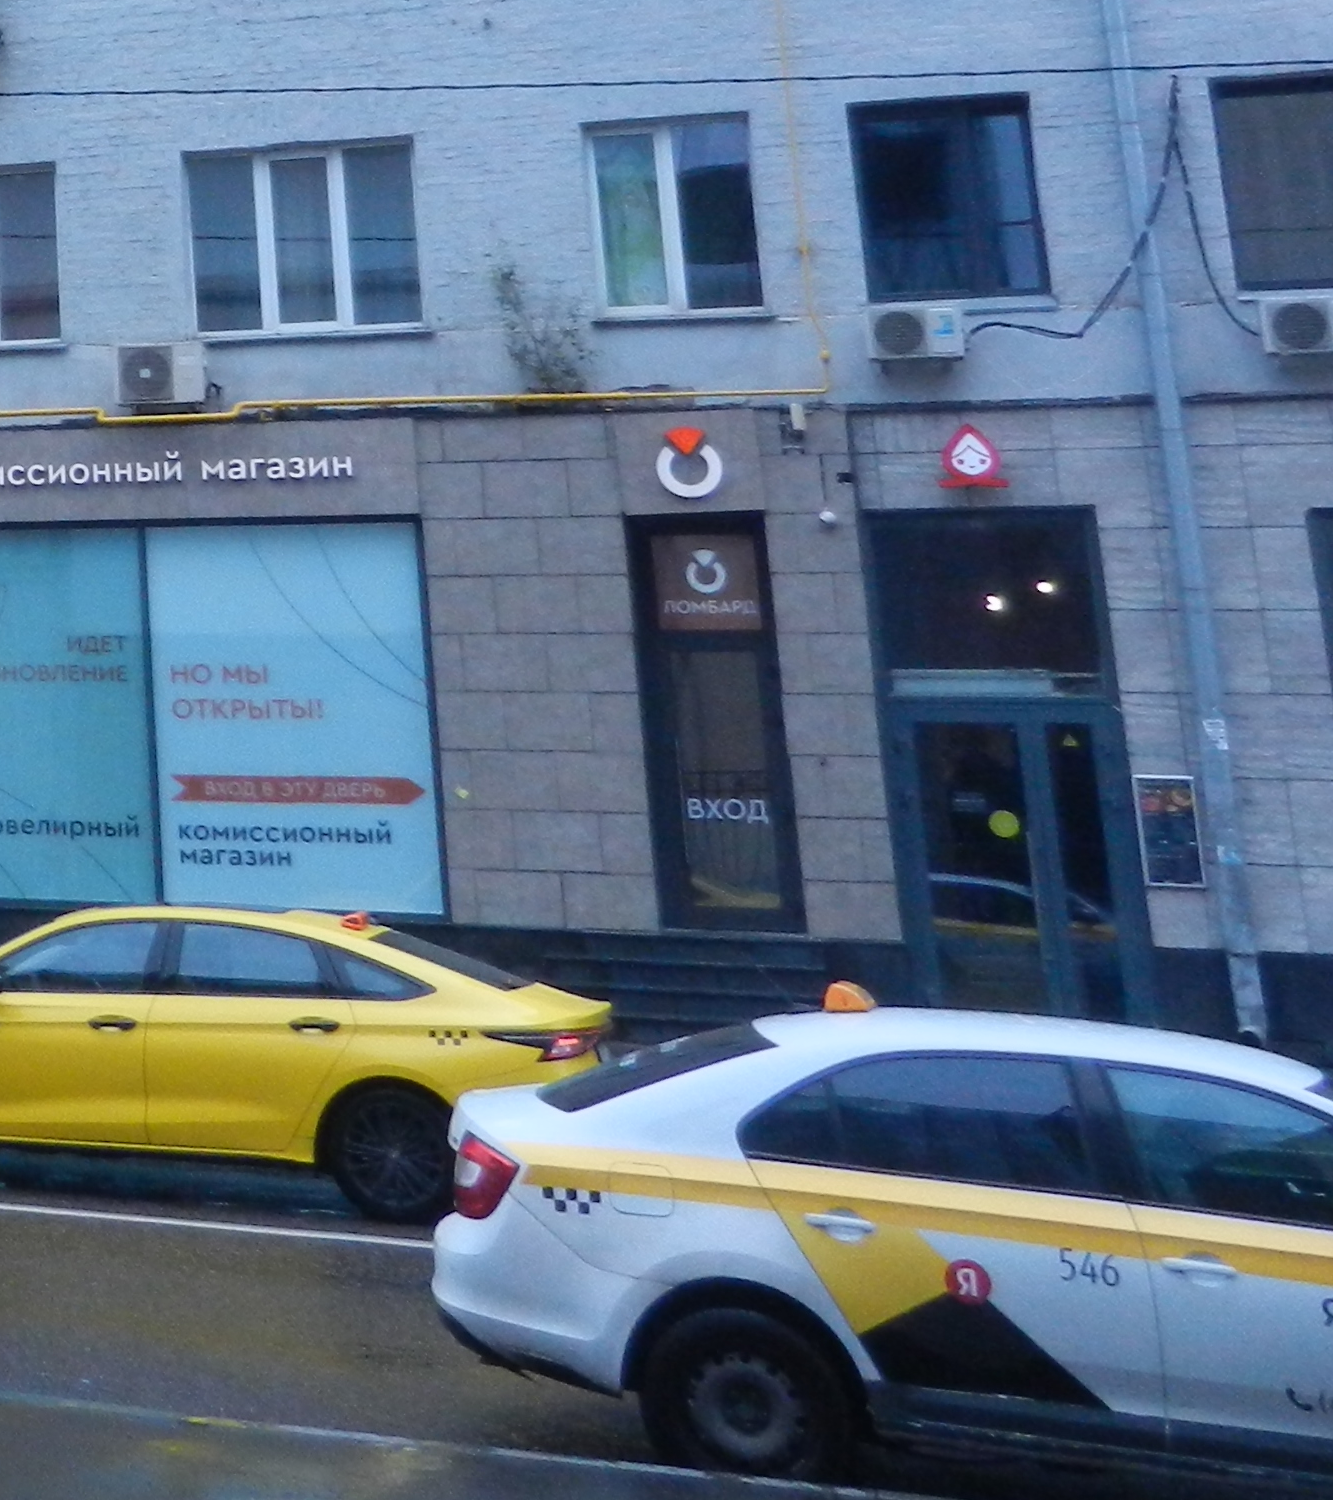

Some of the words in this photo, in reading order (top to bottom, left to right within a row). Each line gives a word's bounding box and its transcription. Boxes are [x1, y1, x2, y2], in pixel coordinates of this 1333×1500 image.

[200, 455, 354, 482] магазин
[663, 599, 757, 615] ЛОМБАРД
[66, 635, 128, 655] ИДЕТ
[169, 664, 212, 684] НО
[221, 664, 269, 684] МЫ
[171, 699, 324, 721] ОТКРЫТЫ!
[204, 780, 256, 799] ВХОД
[261, 781, 273, 796] В
[280, 781, 316, 798] ЭТУ
[323, 781, 387, 800] ДВЕРЬ
[686, 799, 770, 824] ВХОД
[178, 819, 392, 845] комиссионный
[180, 846, 293, 867] магазин
[1058, 1247, 1121, 1287] 546
[955, 1266, 978, 1297] Я
